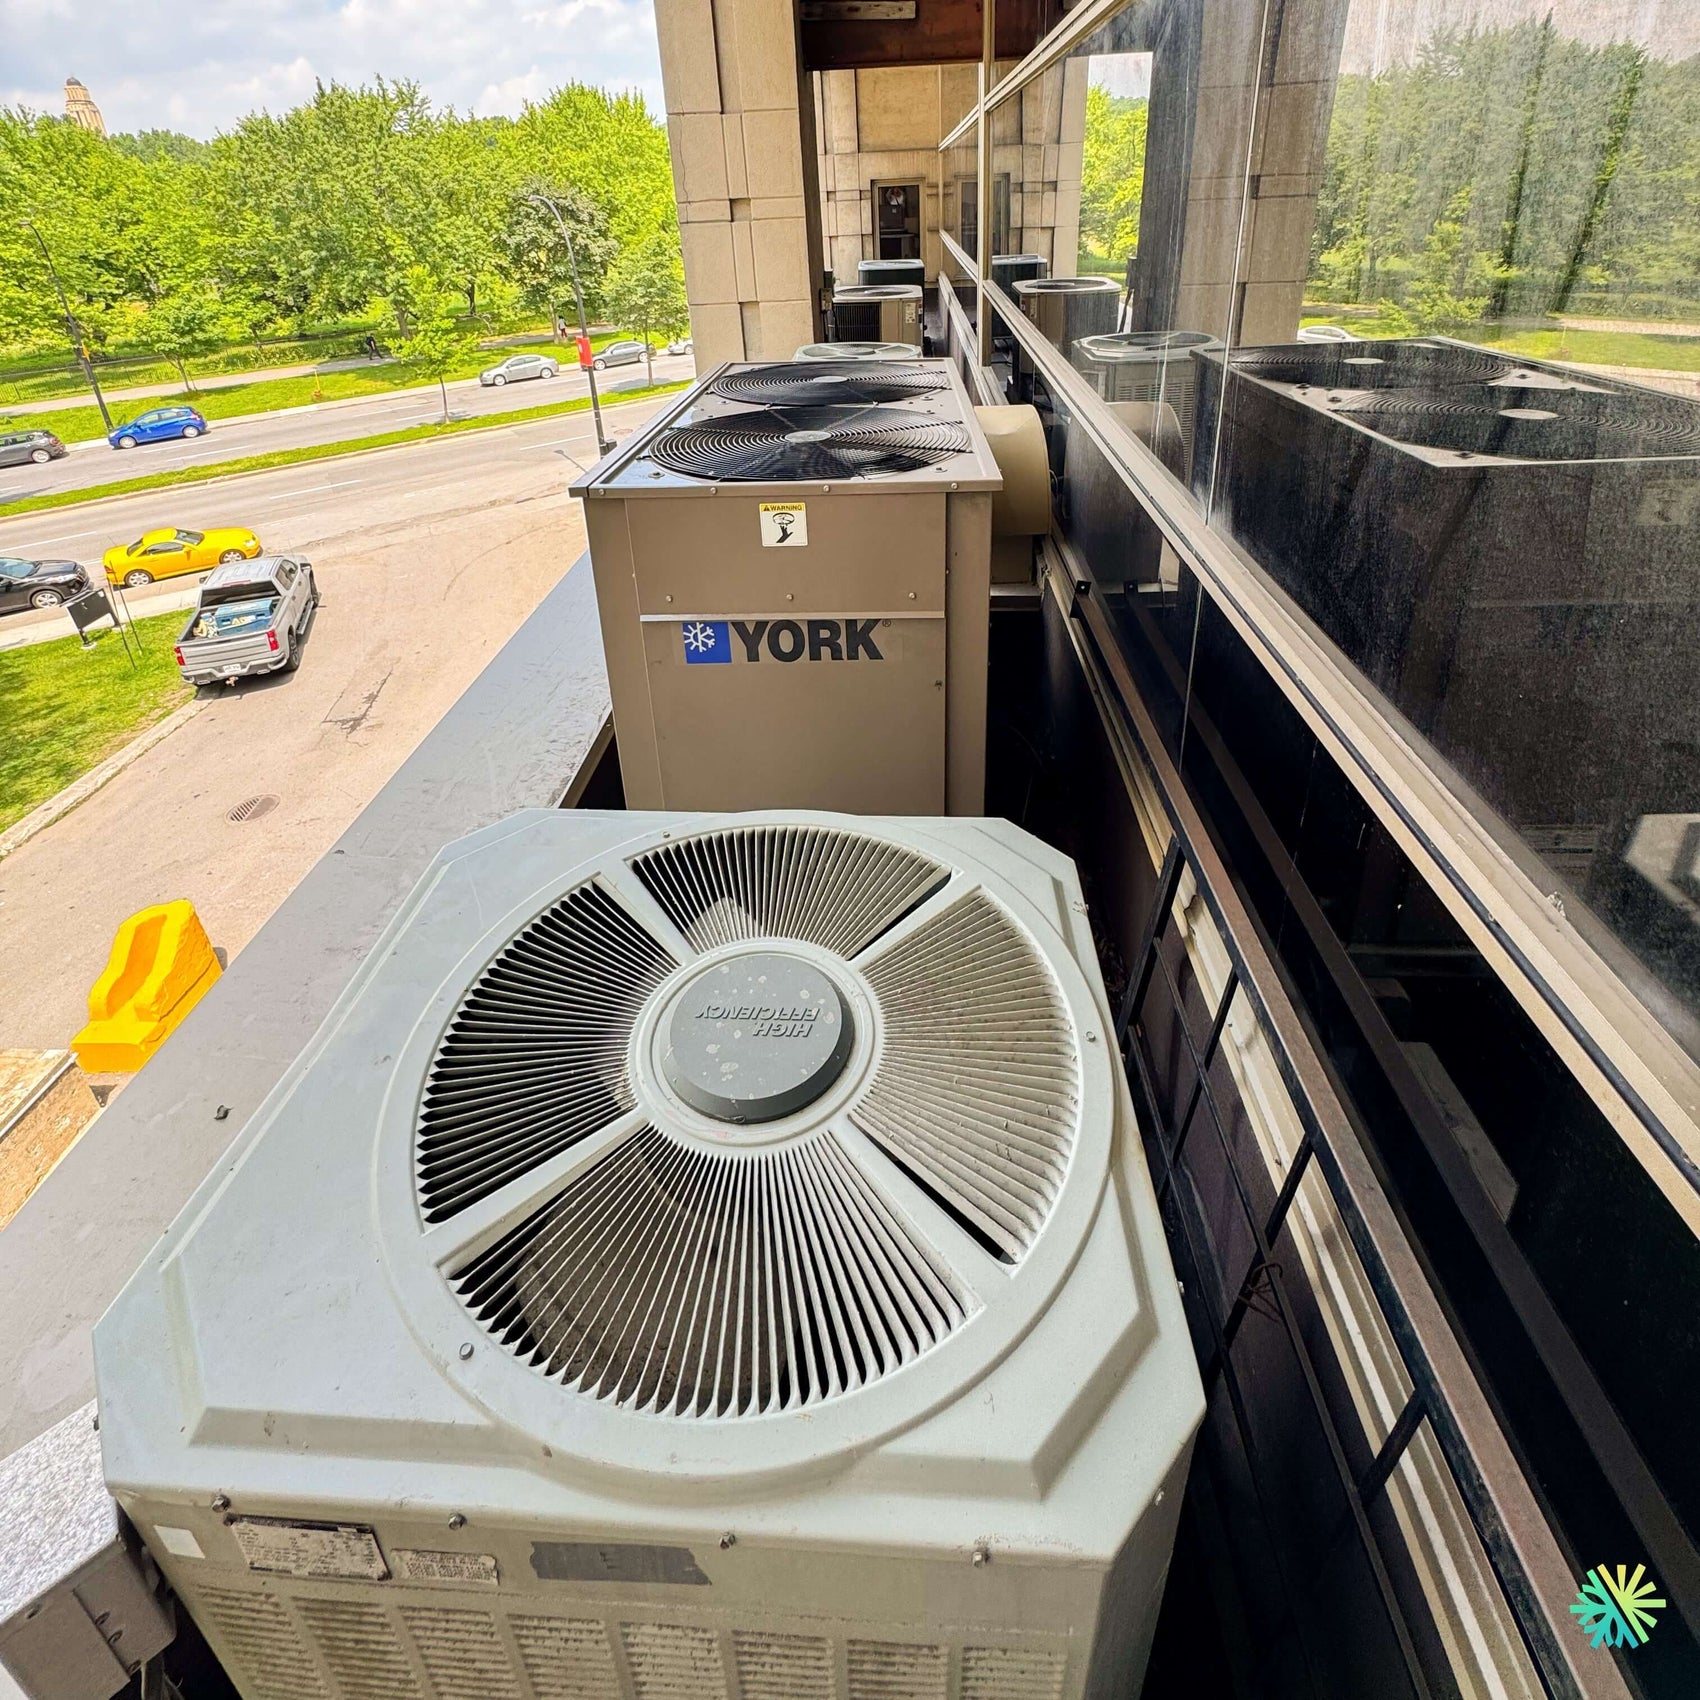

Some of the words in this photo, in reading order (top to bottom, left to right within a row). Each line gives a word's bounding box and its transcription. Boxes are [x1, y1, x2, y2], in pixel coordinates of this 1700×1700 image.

[730, 619, 884, 663] YORK
[695, 1004, 820, 1021] EFFICIENCY
[752, 1022, 813, 1038] HIGH
